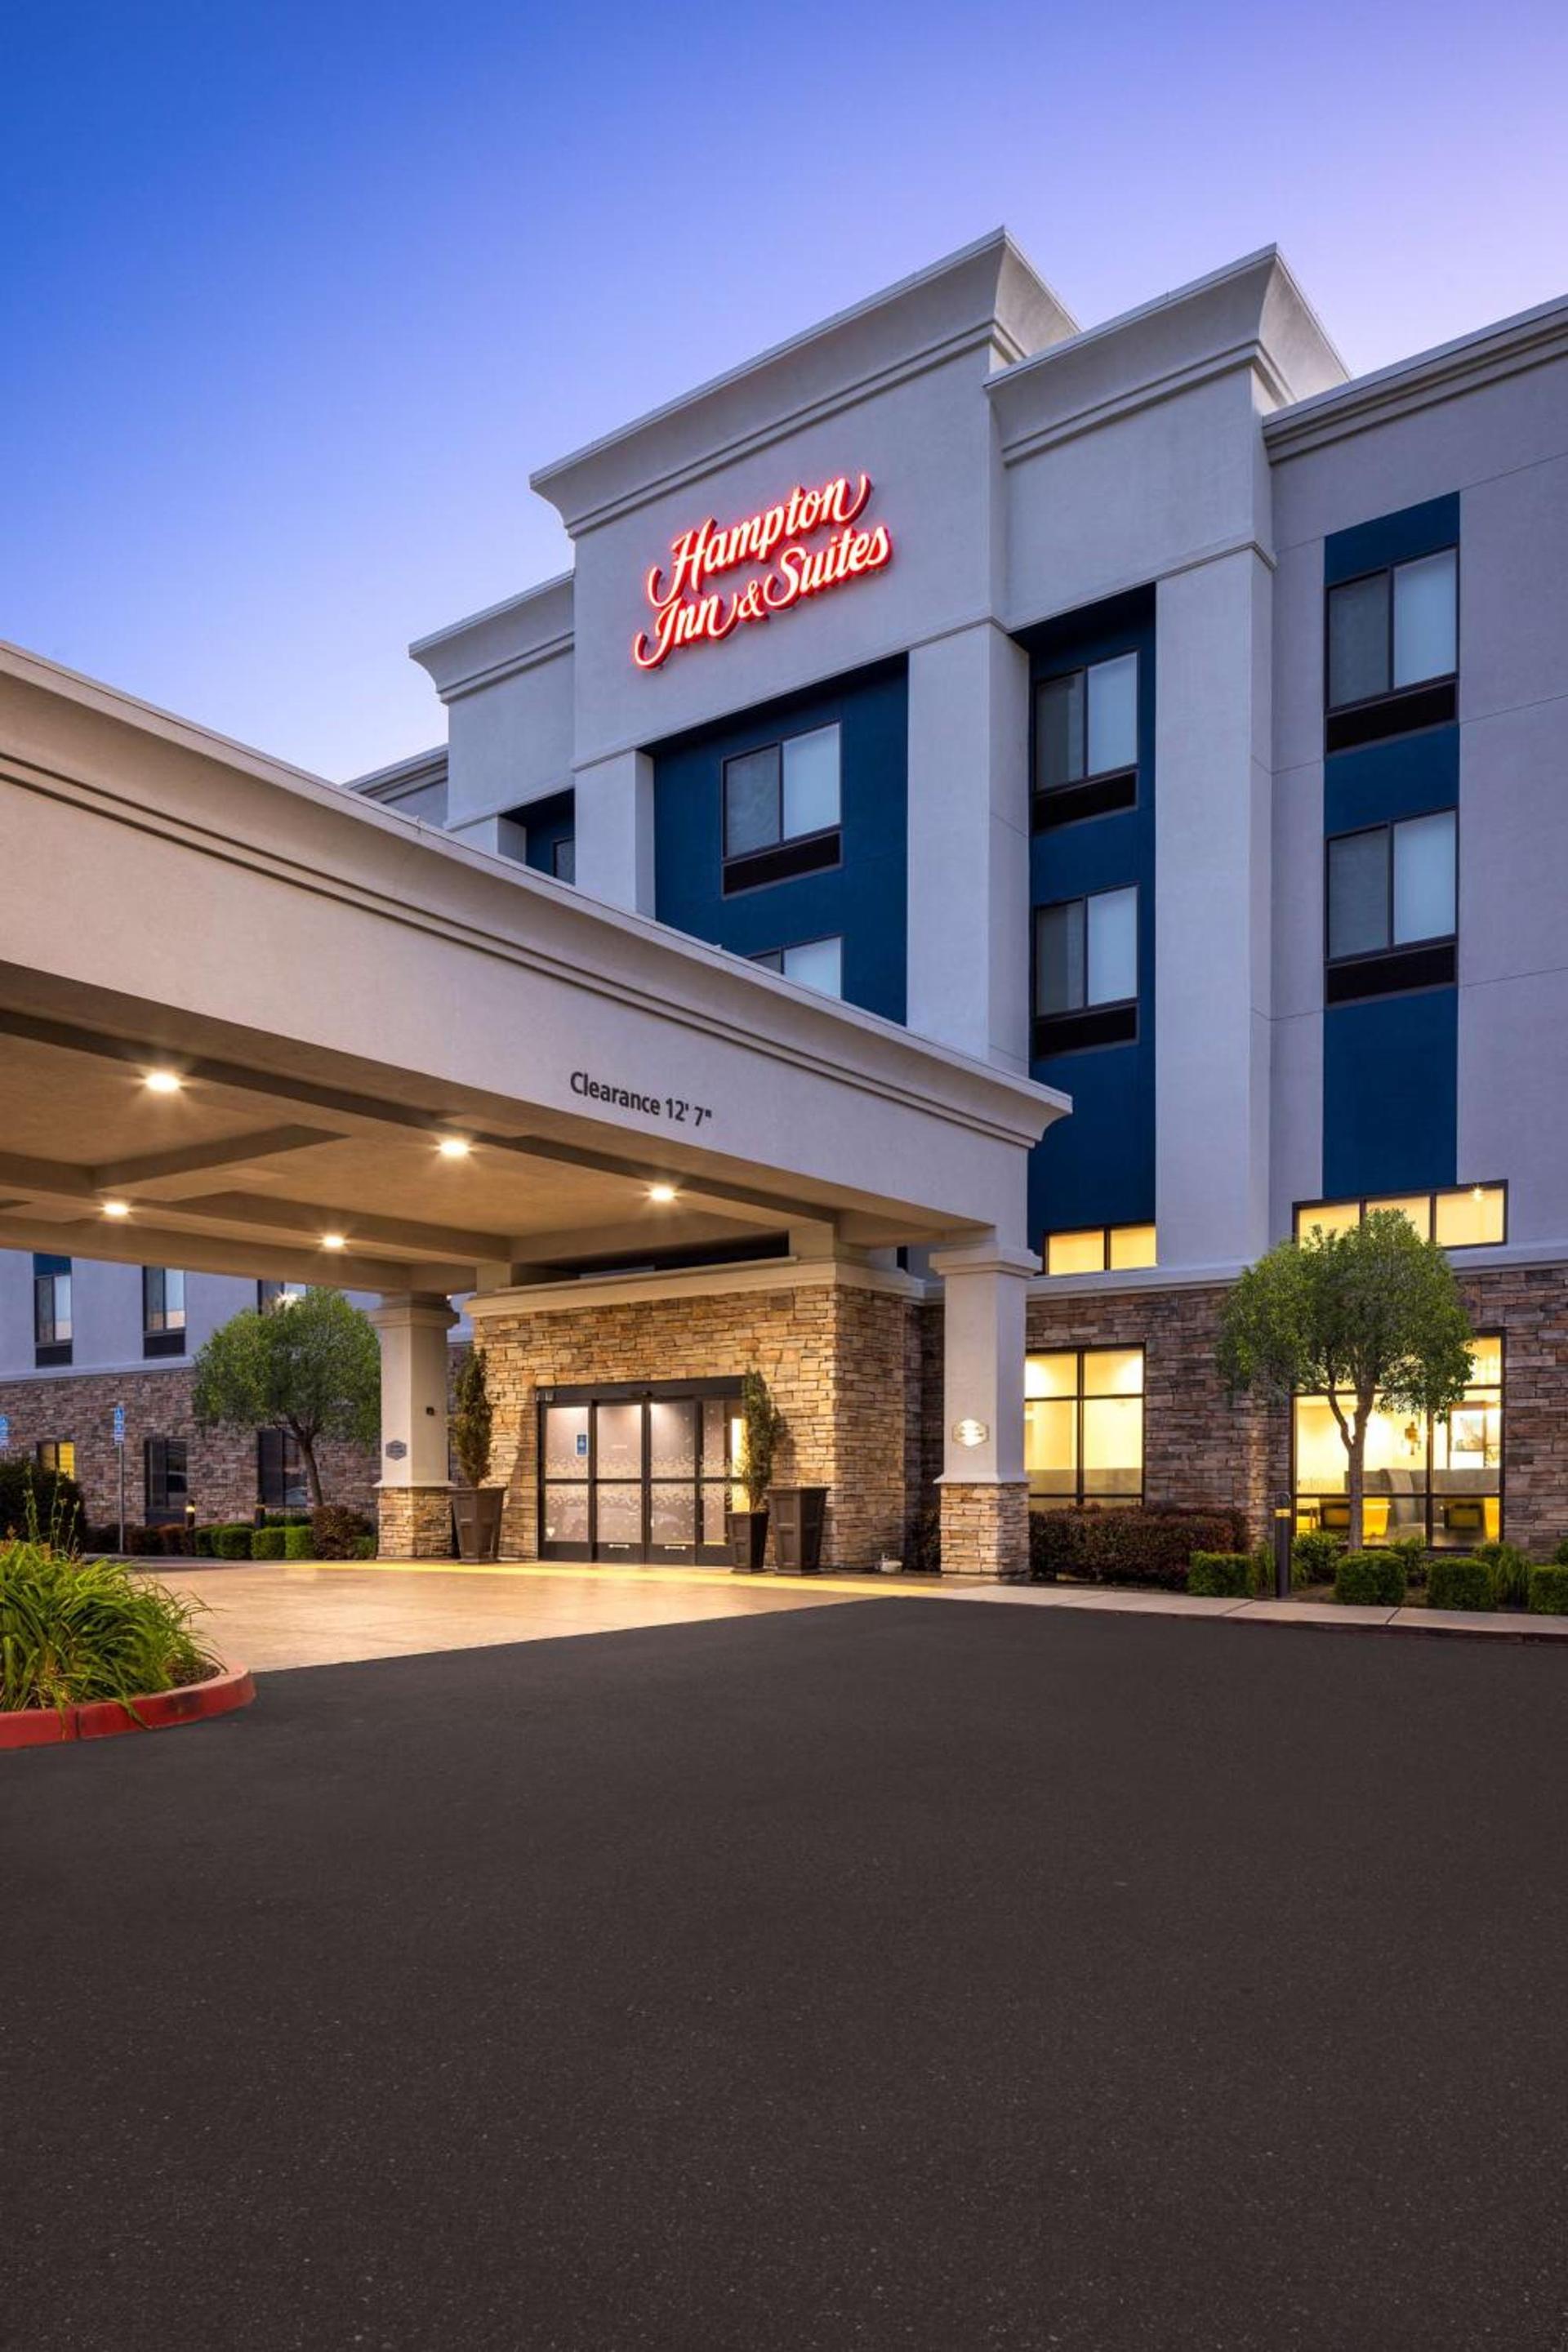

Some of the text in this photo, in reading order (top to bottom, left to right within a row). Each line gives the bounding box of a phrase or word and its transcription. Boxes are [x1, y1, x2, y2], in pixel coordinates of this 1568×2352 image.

[634, 525, 893, 668] Inn & Suites
[648, 474, 872, 609] Hampton
[570, 1071, 661, 1116] Clearance
[665, 1098, 689, 1122] 12'
